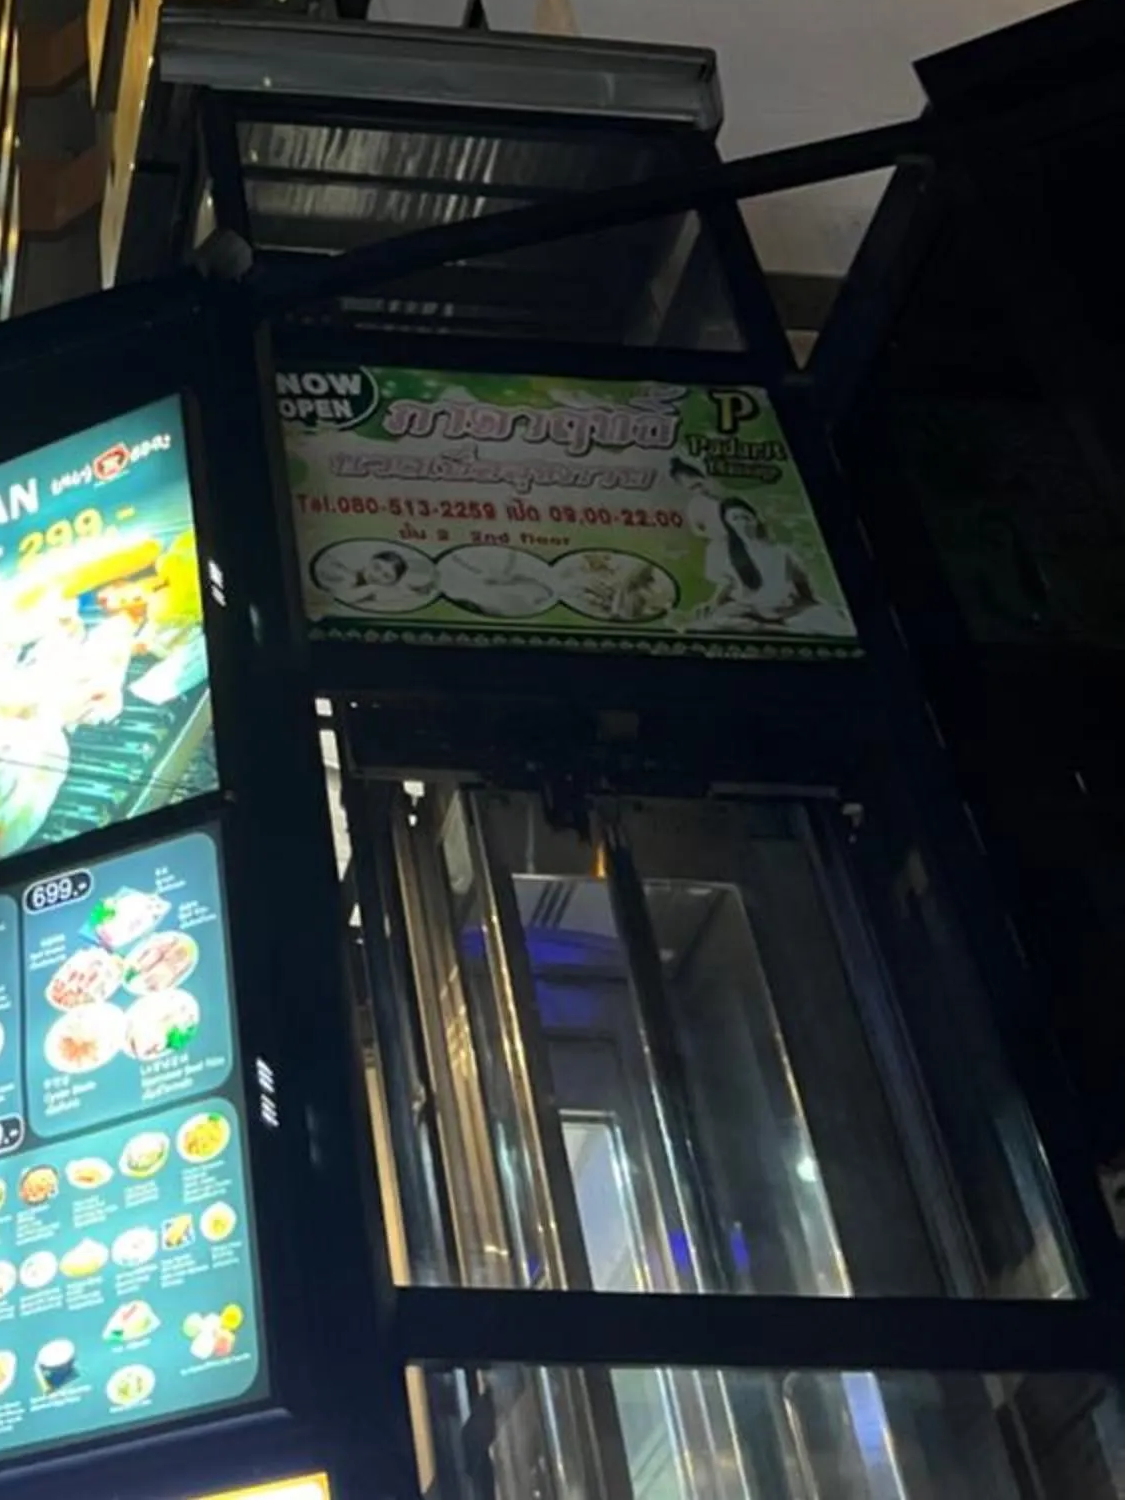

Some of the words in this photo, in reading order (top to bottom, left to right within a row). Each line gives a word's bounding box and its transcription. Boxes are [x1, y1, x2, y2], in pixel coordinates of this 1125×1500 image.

[275, 372, 362, 397] NOW
[279, 397, 354, 421] OPEN
[711, 390, 758, 433] P
[31, 877, 88, 908] 699.-
